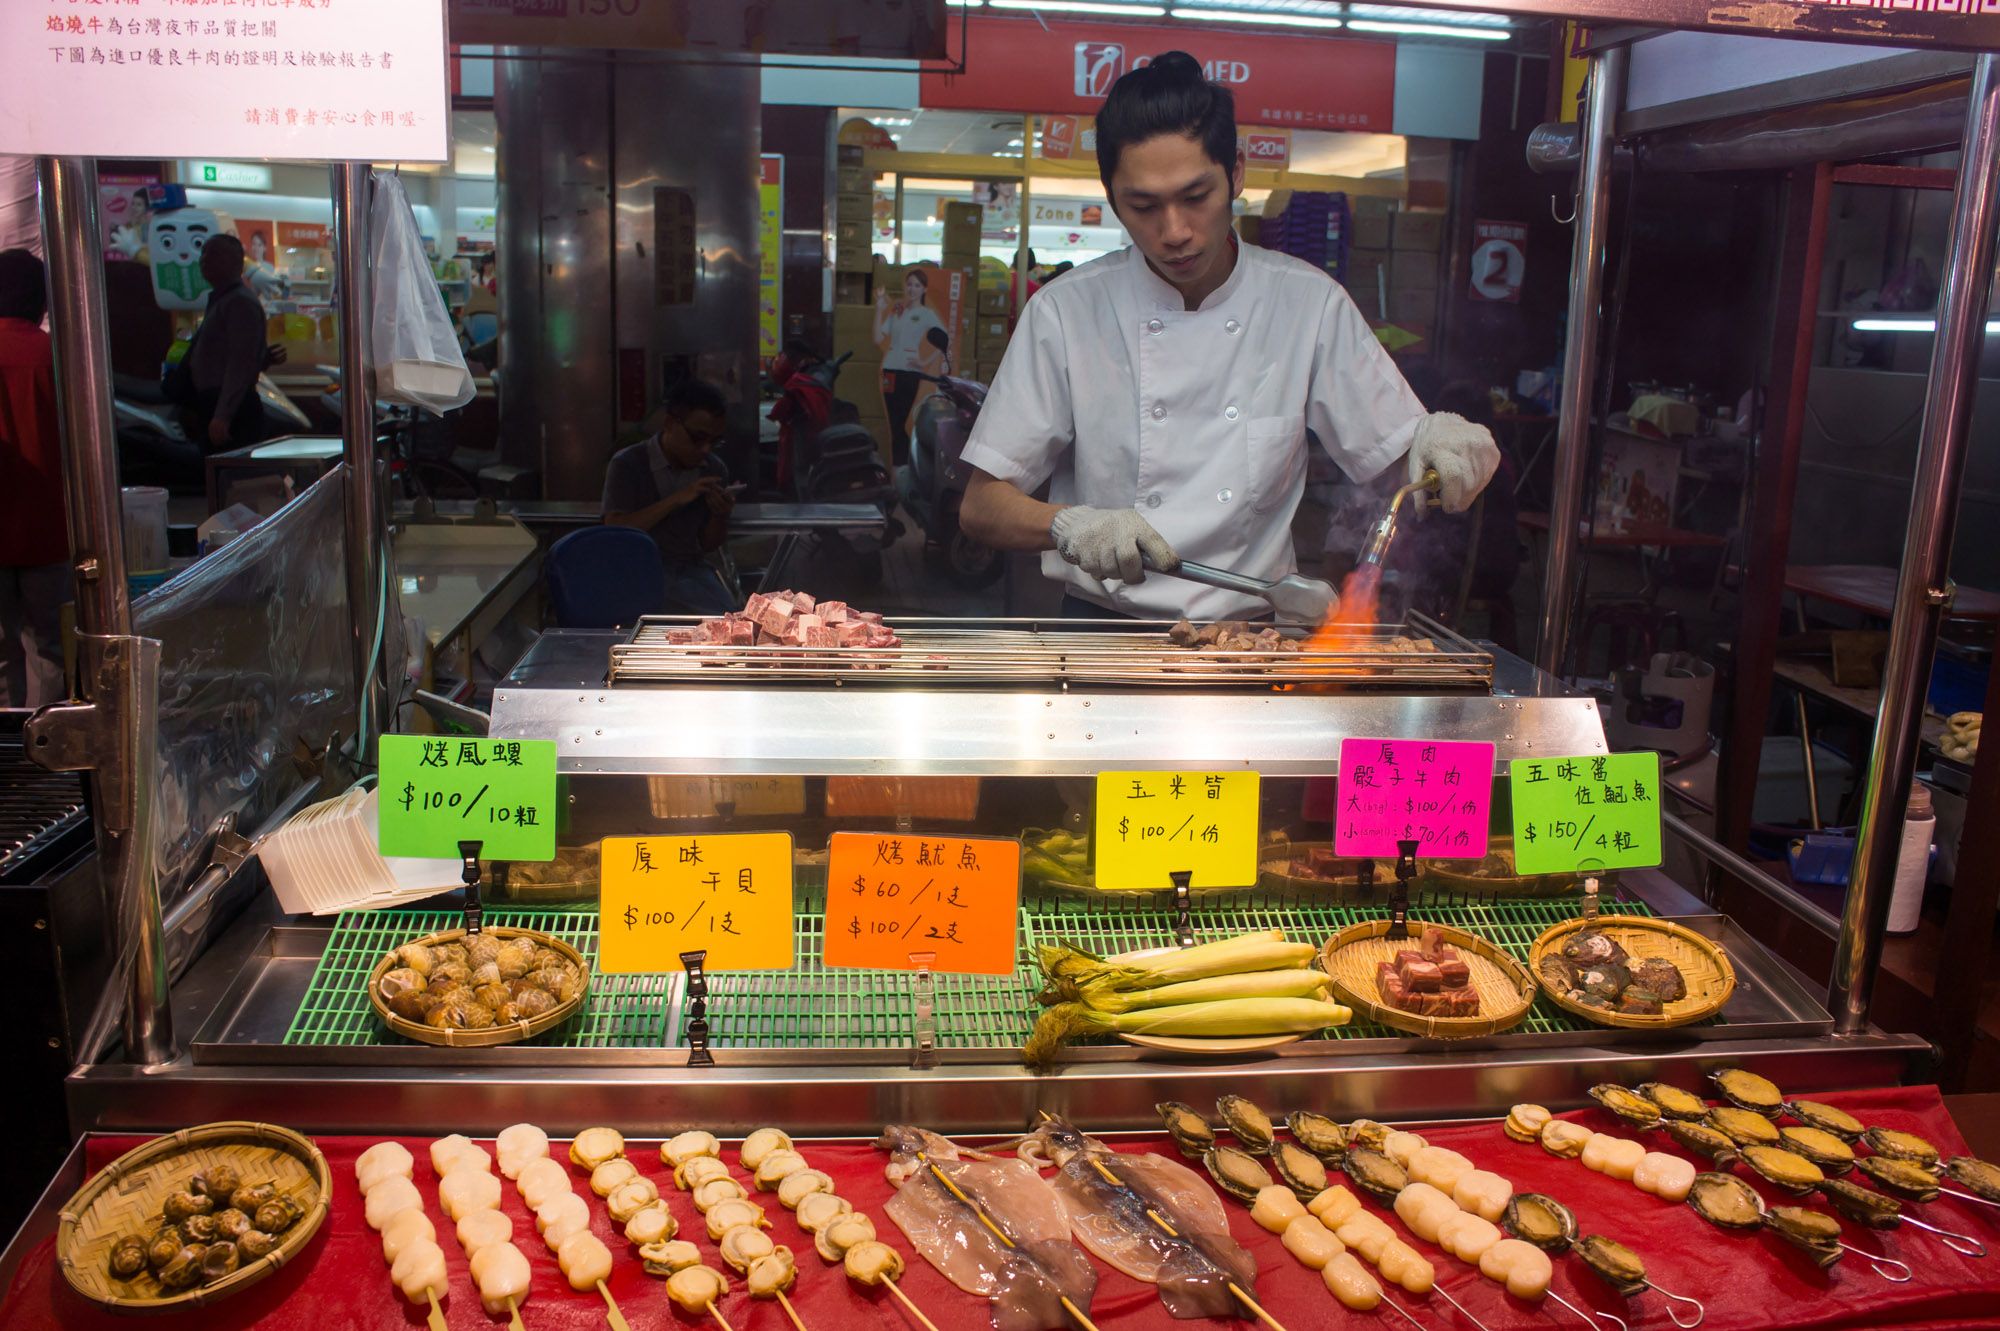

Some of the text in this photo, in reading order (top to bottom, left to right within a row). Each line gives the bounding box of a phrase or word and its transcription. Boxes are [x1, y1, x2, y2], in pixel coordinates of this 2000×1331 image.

[46, 15, 278, 38] 焰燒牛為台灣夜市品質把關
[49, 46, 394, 70] 下圖為進口優良牛肉的證明及檢驗報告書
[1035, 205, 1075, 221] Zone
[1483, 250, 1509, 286] 2
[419, 740, 523, 768] 烤風螺
[1126, 774, 1226, 800] 玉米筍
[1353, 764, 1461, 790] 骰子牛肉
[1574, 779, 1652, 806] 佐鮑魚
[632, 839, 704, 874] 原味
[872, 839, 981, 872] 烤魷魚
[701, 868, 757, 894] 干貝
